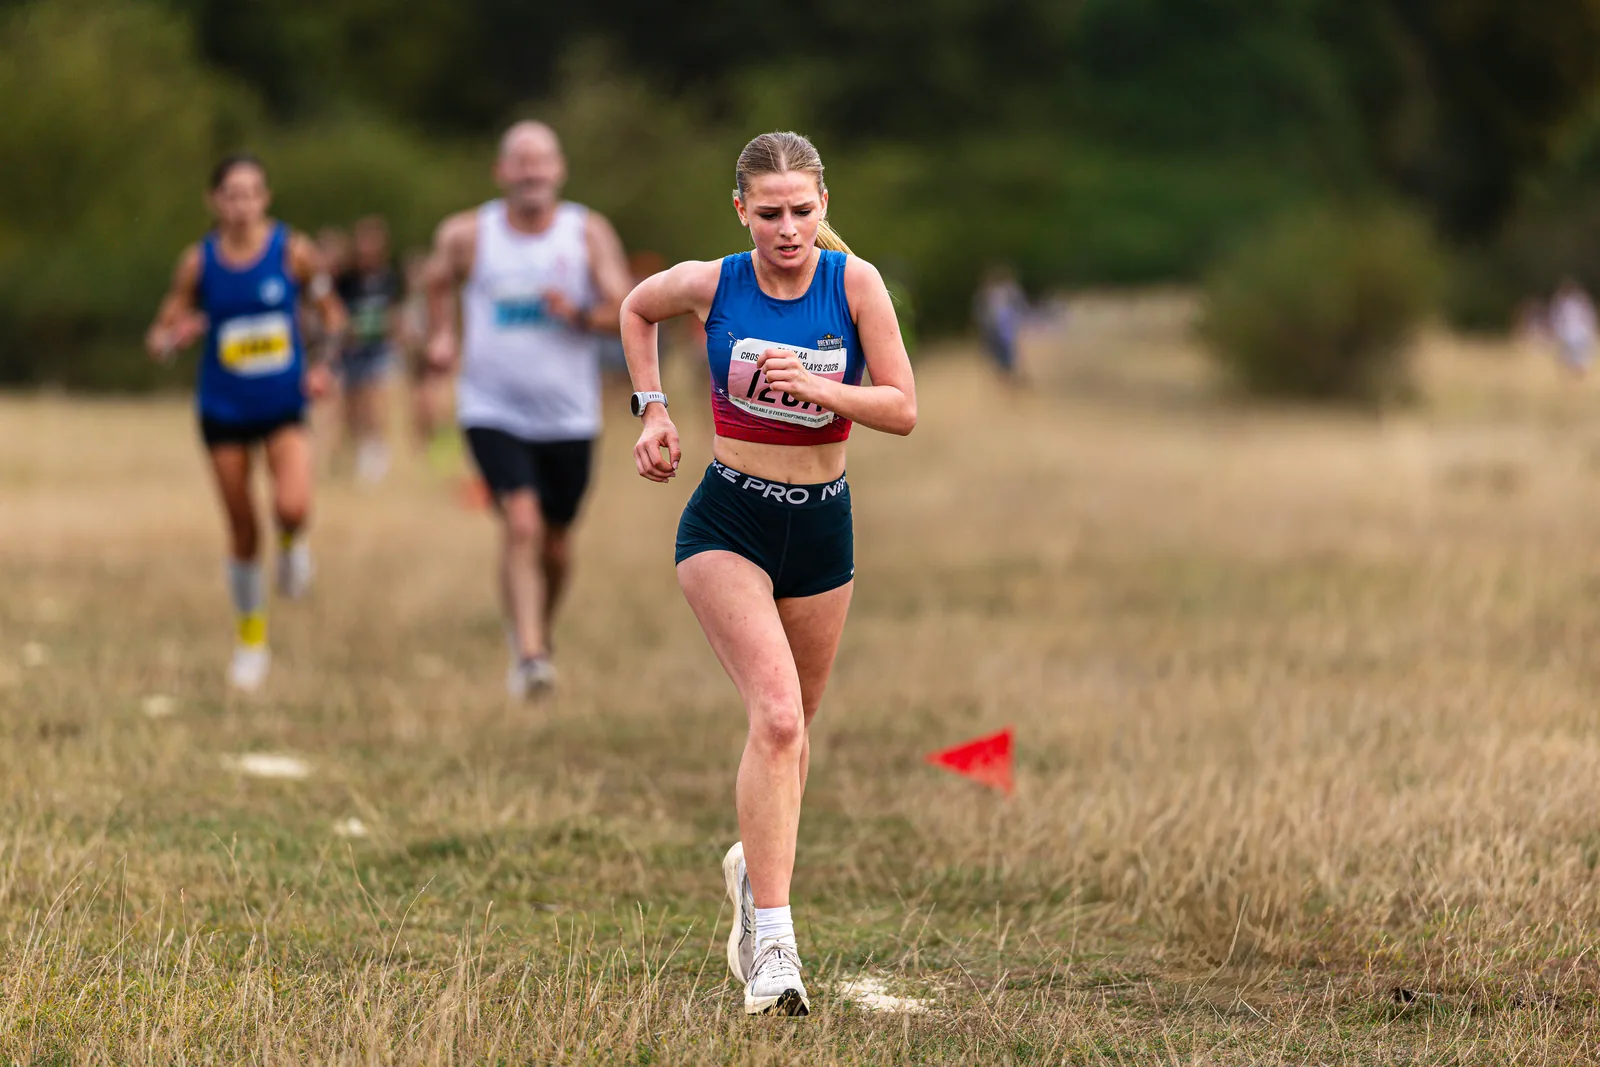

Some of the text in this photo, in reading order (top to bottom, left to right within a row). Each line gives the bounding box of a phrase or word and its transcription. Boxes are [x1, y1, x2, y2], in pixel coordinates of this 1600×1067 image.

[740, 352, 759, 361] CROS
[802, 361, 822, 371] ELAYS
[798, 351, 807, 360] AA
[746, 369, 822, 412] 12
[749, 405, 768, 413] AVAILABLE
[713, 459, 846, 505] KE PRO NI
